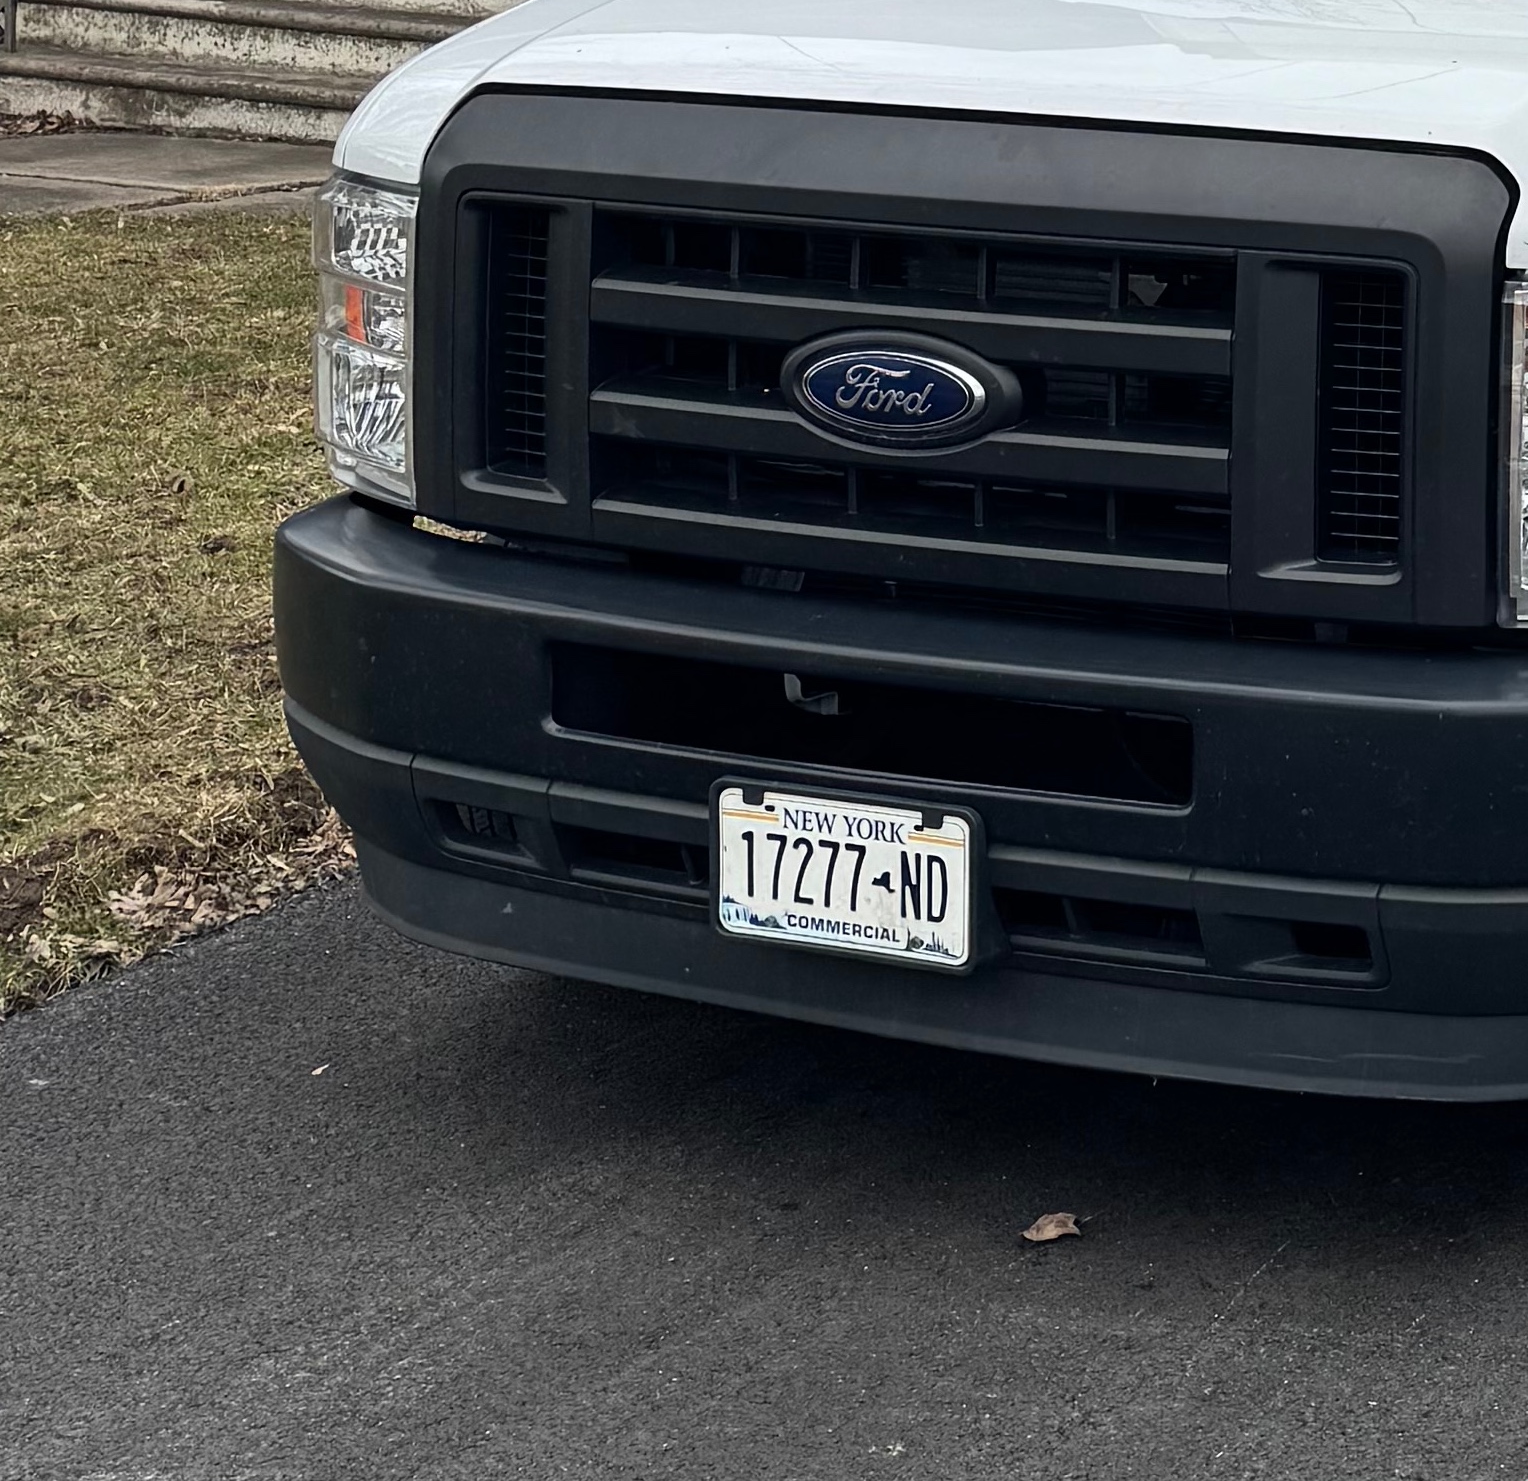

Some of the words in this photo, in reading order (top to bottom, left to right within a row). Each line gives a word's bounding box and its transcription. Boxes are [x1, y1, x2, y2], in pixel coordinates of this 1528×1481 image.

[835, 363, 935, 417] Ford
[782, 806, 836, 836] NEW
[842, 814, 907, 845] YORK
[741, 829, 867, 912] 17277
[900, 849, 949, 924] ND
[786, 913, 901, 944] COMMERCIAL
